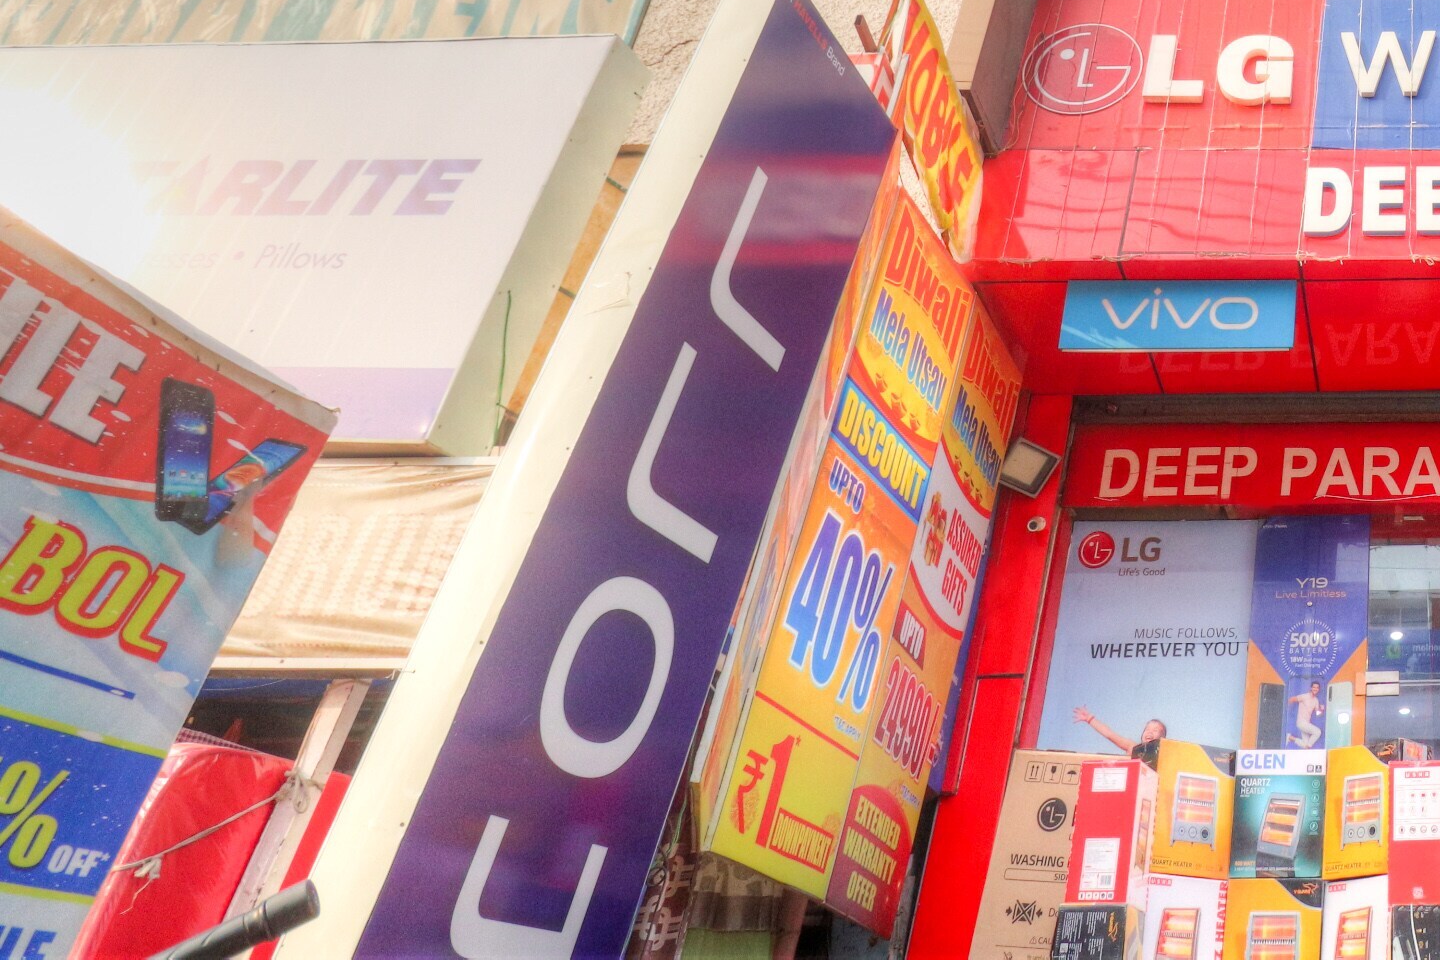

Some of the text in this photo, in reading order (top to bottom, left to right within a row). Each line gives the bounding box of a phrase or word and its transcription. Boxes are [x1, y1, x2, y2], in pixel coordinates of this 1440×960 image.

[826, 46, 846, 77] Brand
[1141, 33, 1297, 107] LG
[254, 242, 347, 270] Pillows
[885, 201, 974, 370] Diwali
[1101, 287, 1259, 333] vivo
[869, 287, 948, 416] Mela Utsav
[962, 311, 1021, 448] Diwali
[837, 387, 928, 510] DISCOUNT
[952, 384, 1001, 487] Mela Utsav
[829, 457, 866, 515] UPTO
[1100, 444, 1258, 500] DEEP
[947, 508, 983, 580] ASSURED
[1121, 537, 1162, 562] LG
[0, 513, 187, 663] BOL
[942, 557, 968, 617] GIFTS
[1118, 567, 1166, 577] Life's Good
[1275, 590, 1347, 599] Live Limitless
[1296, 577, 1328, 589] Y19
[783, 507, 896, 714] 40%
[899, 611, 925, 660] UPTO
[1134, 626, 1239, 640] MUSIC FOLLOWS,
[1090, 641, 1240, 659] WHEREVER YOU
[1290, 631, 1330, 648] 5000
[1241, 753, 1286, 770] GLEN
[1241, 778, 1271, 787] QUARTZ
[1241, 786, 1265, 795] HEATER
[771, 811, 834, 870] DOWNPAYMENT
[855, 794, 901, 851] EXTENDED
[842, 826, 897, 886] WARRANTY
[1010, 853, 1064, 868] WASHING
[847, 870, 878, 913] OFFER
[1216, 881, 1229, 942] HEATER
